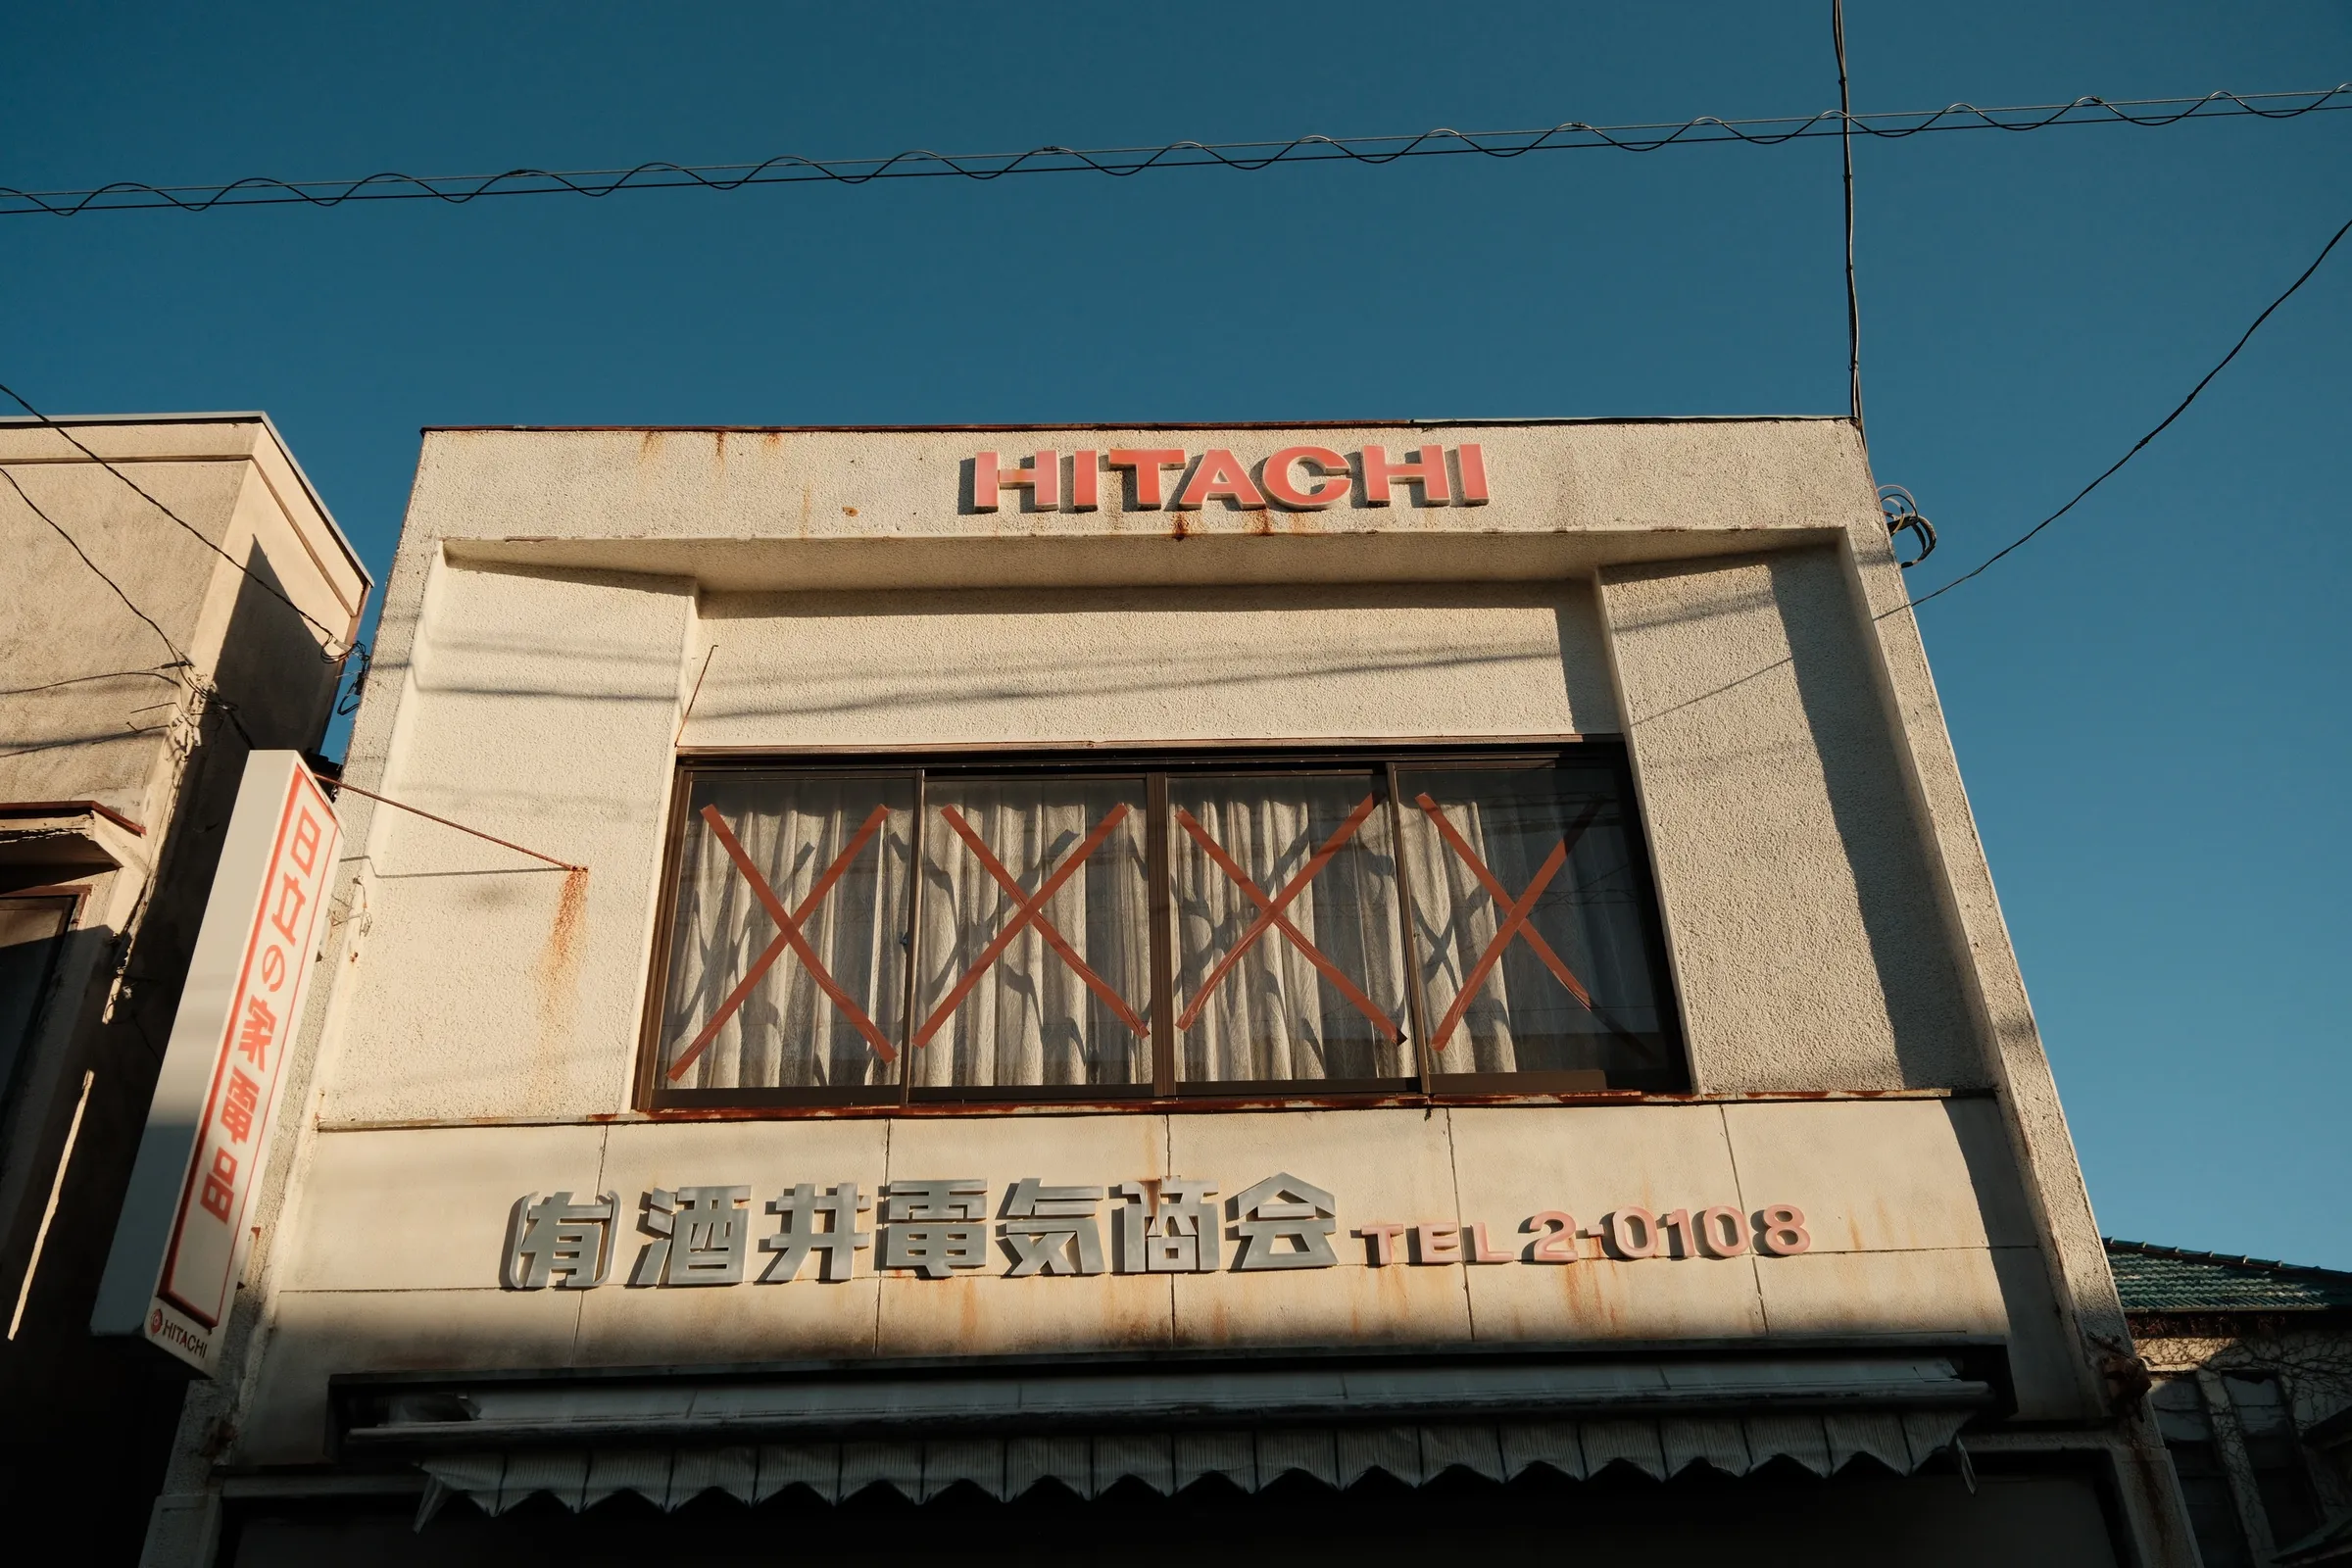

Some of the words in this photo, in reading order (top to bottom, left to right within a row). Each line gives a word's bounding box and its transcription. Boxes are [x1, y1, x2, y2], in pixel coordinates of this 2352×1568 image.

[973, 443, 1490, 512] HITACHI
[200, 805, 322, 1224] 日立の家電品
[1360, 1221, 1514, 1266] TEL
[1528, 1204, 1811, 1263] 2-0108
[163, 1319, 208, 1359] HITACHI
